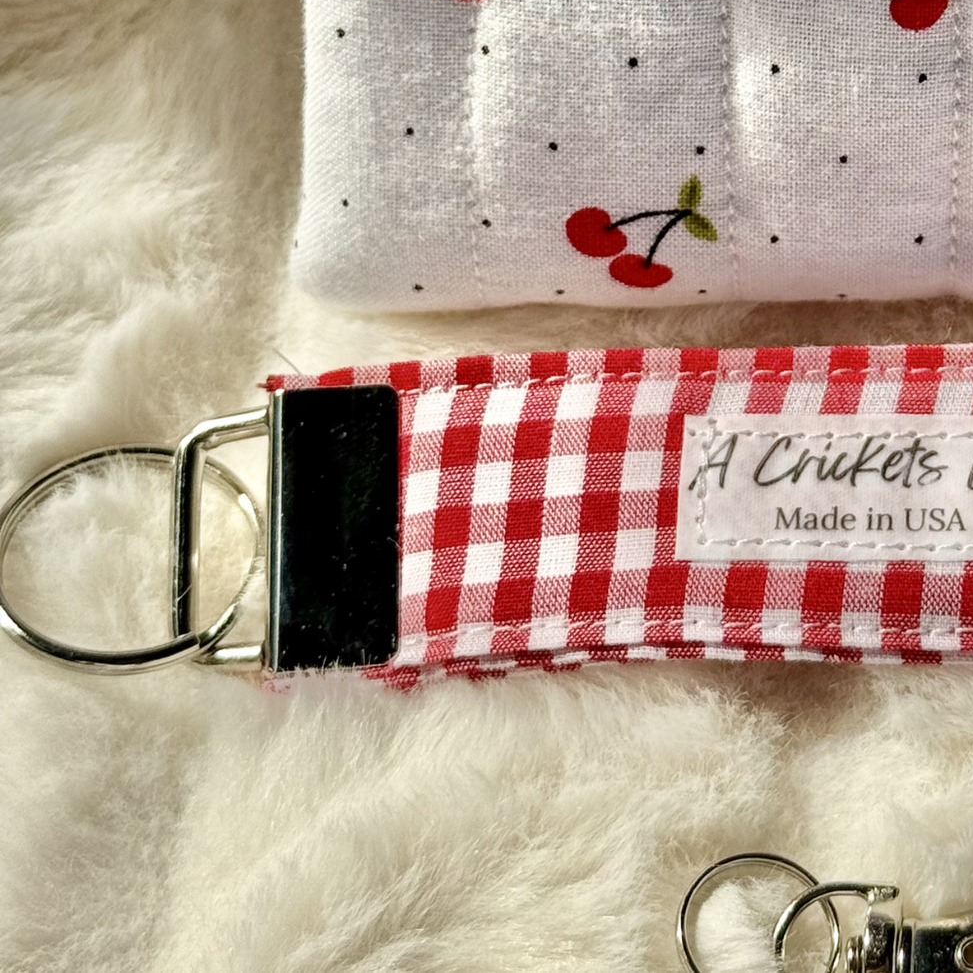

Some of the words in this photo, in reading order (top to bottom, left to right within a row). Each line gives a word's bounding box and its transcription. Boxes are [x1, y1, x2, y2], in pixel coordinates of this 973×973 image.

[688, 433, 740, 491] A
[753, 434, 948, 489] Crickets
[774, 506, 857, 532] Made
[867, 507, 894, 532] in
[904, 507, 967, 532] USA
